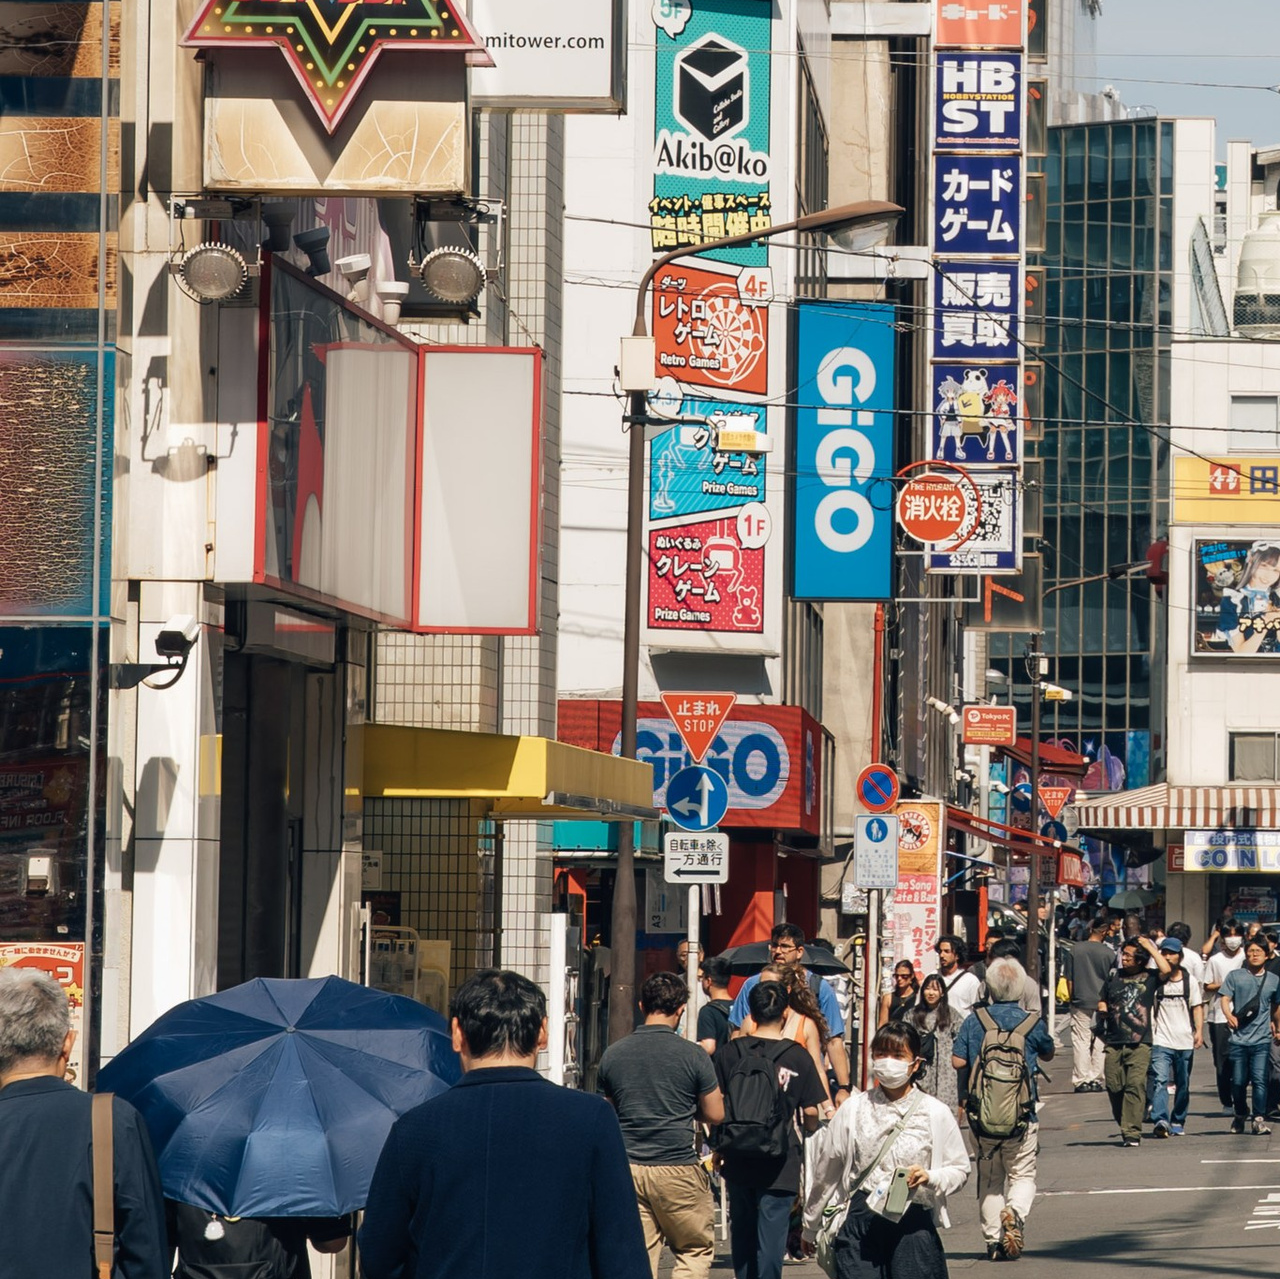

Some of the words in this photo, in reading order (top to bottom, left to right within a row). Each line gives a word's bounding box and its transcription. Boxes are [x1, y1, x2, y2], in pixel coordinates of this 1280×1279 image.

[943, 60, 1016, 93] HB
[943, 93, 1015, 101] HOBBYSTATION
[942, 100, 1015, 133] ST
[657, 138, 768, 177] Akib@ko
[942, 168, 1014, 203] カード
[940, 209, 1014, 242] ゲーム
[661, 275, 687, 290] ダーツ
[745, 275, 768, 297] 4F
[941, 272, 1011, 307] 販売
[659, 296, 707, 320] レトロ
[674, 322, 722, 347] ゲーム
[941, 313, 1011, 347] 買取
[661, 353, 686, 366] Retro
[689, 355, 721, 370] Games
[815, 347, 876, 553] GiGO
[702, 481, 726, 495] Prize
[727, 482, 758, 497] Games
[911, 482, 925, 491] FIRE
[905, 494, 961, 522] 消火栓
[744, 514, 765, 537] 1F
[656, 535, 702, 551] ぬいぐるみ
[656, 554, 720, 578] クレーン
[675, 579, 721, 603] ゲーム
[655, 607, 679, 620] Prize
[680, 609, 711, 622] Games
[676, 700, 721, 716] 止まれ
[684, 719, 715, 733] STOP
[670, 838, 723, 851] 自転車を除く
[670, 854, 723, 866] 一方通行
[1195, 849, 1256, 869] COIN
[910, 879, 931, 891] Song
[651, 914, 661, 929] A3
[925, 907, 936, 952] アニソン
